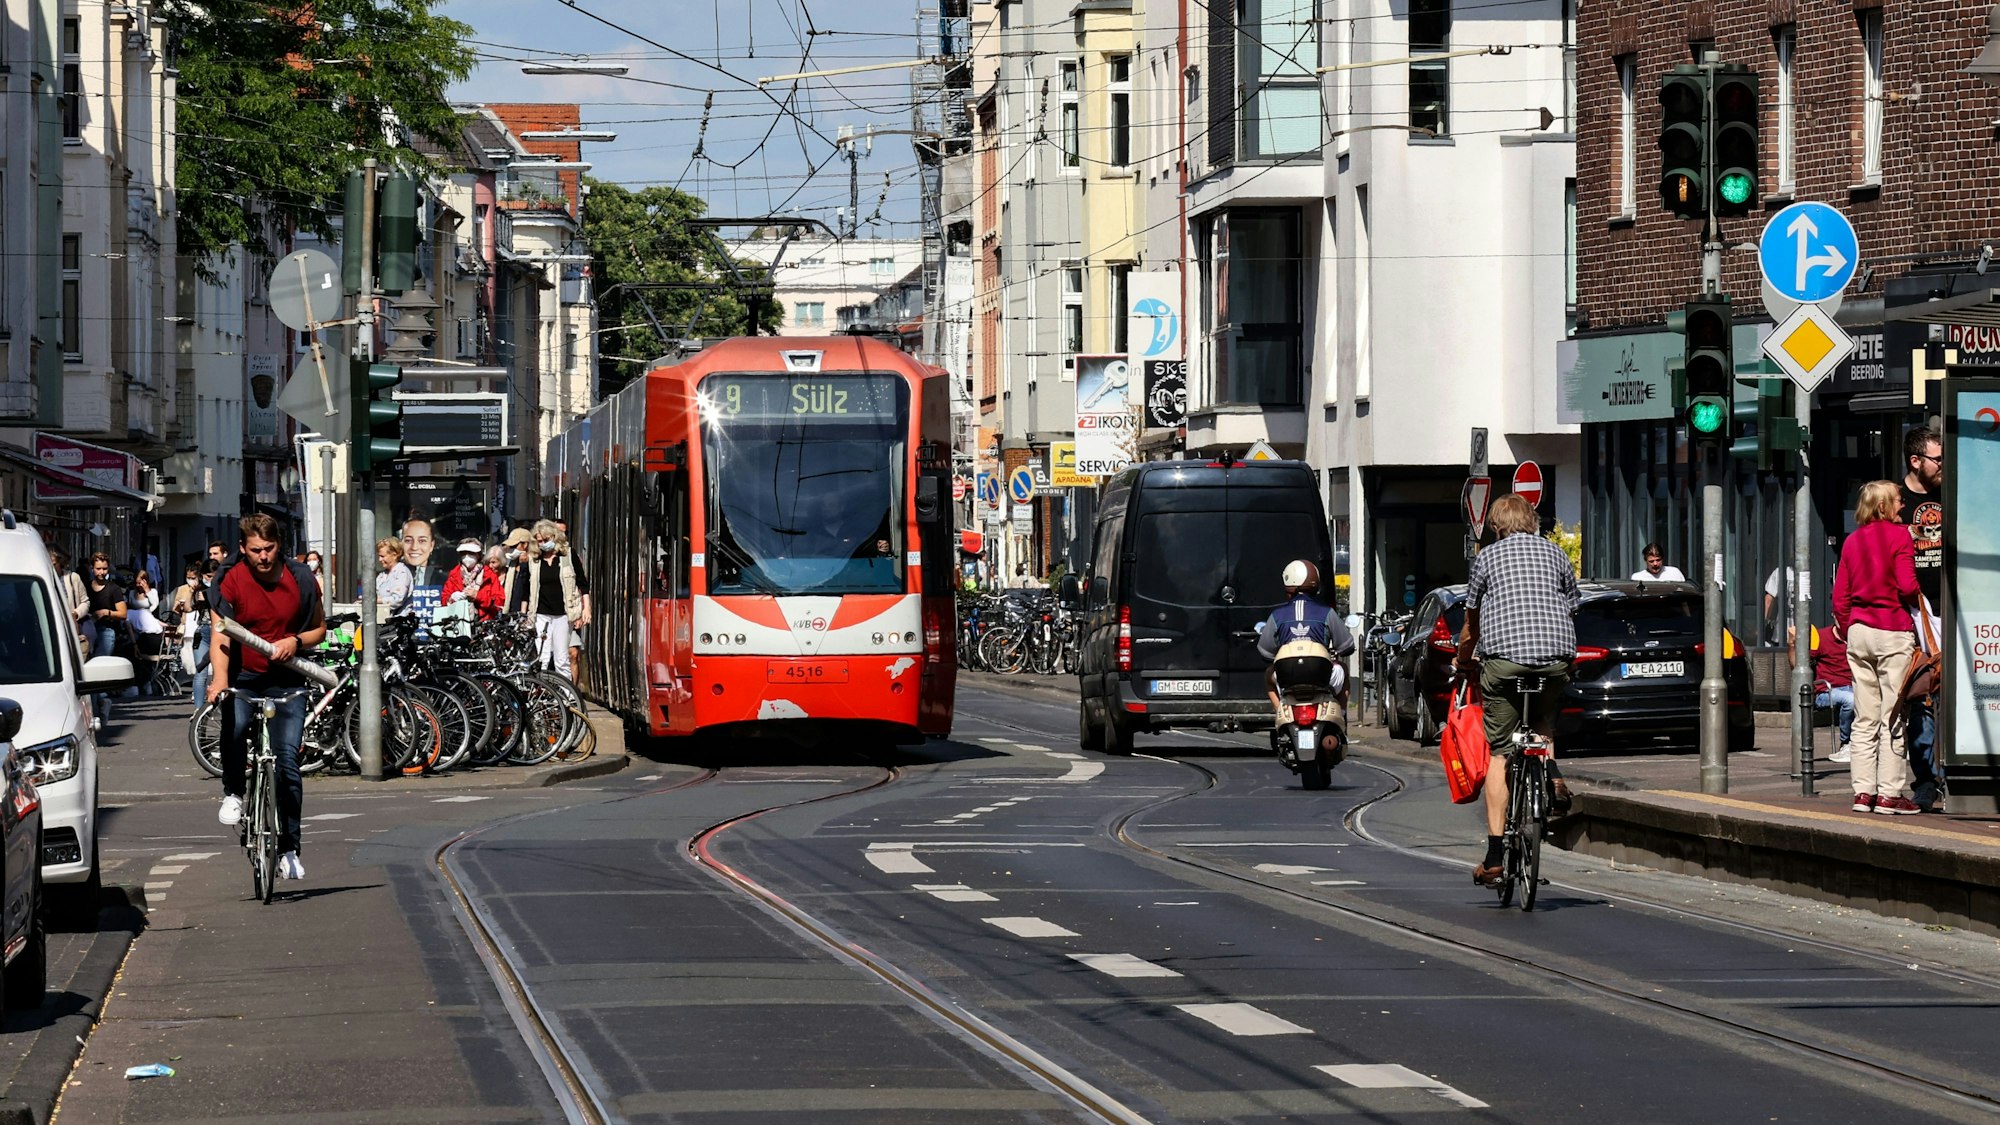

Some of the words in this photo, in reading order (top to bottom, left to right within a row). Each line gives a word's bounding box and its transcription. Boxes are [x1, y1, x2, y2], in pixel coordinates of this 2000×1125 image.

[1850, 334, 1884, 361] PETE
[1850, 364, 1885, 381] BEERDIG
[1912, 348, 1958, 405] H
[726, 384, 741, 414] 9
[792, 383, 848, 414] Sülz
[1055, 476, 1092, 484] APADANA
[793, 619, 812, 629] KVB
[786, 666, 823, 677] 4516
[1628, 665, 1635, 674] K
[1641, 663, 1655, 673] EA
[1657, 662, 1682, 673] 2110
[1973, 660, 2000, 674] Pro
[1157, 681, 1171, 692] GM
[1176, 681, 1190, 692] GE
[1192, 681, 1211, 692] 600
